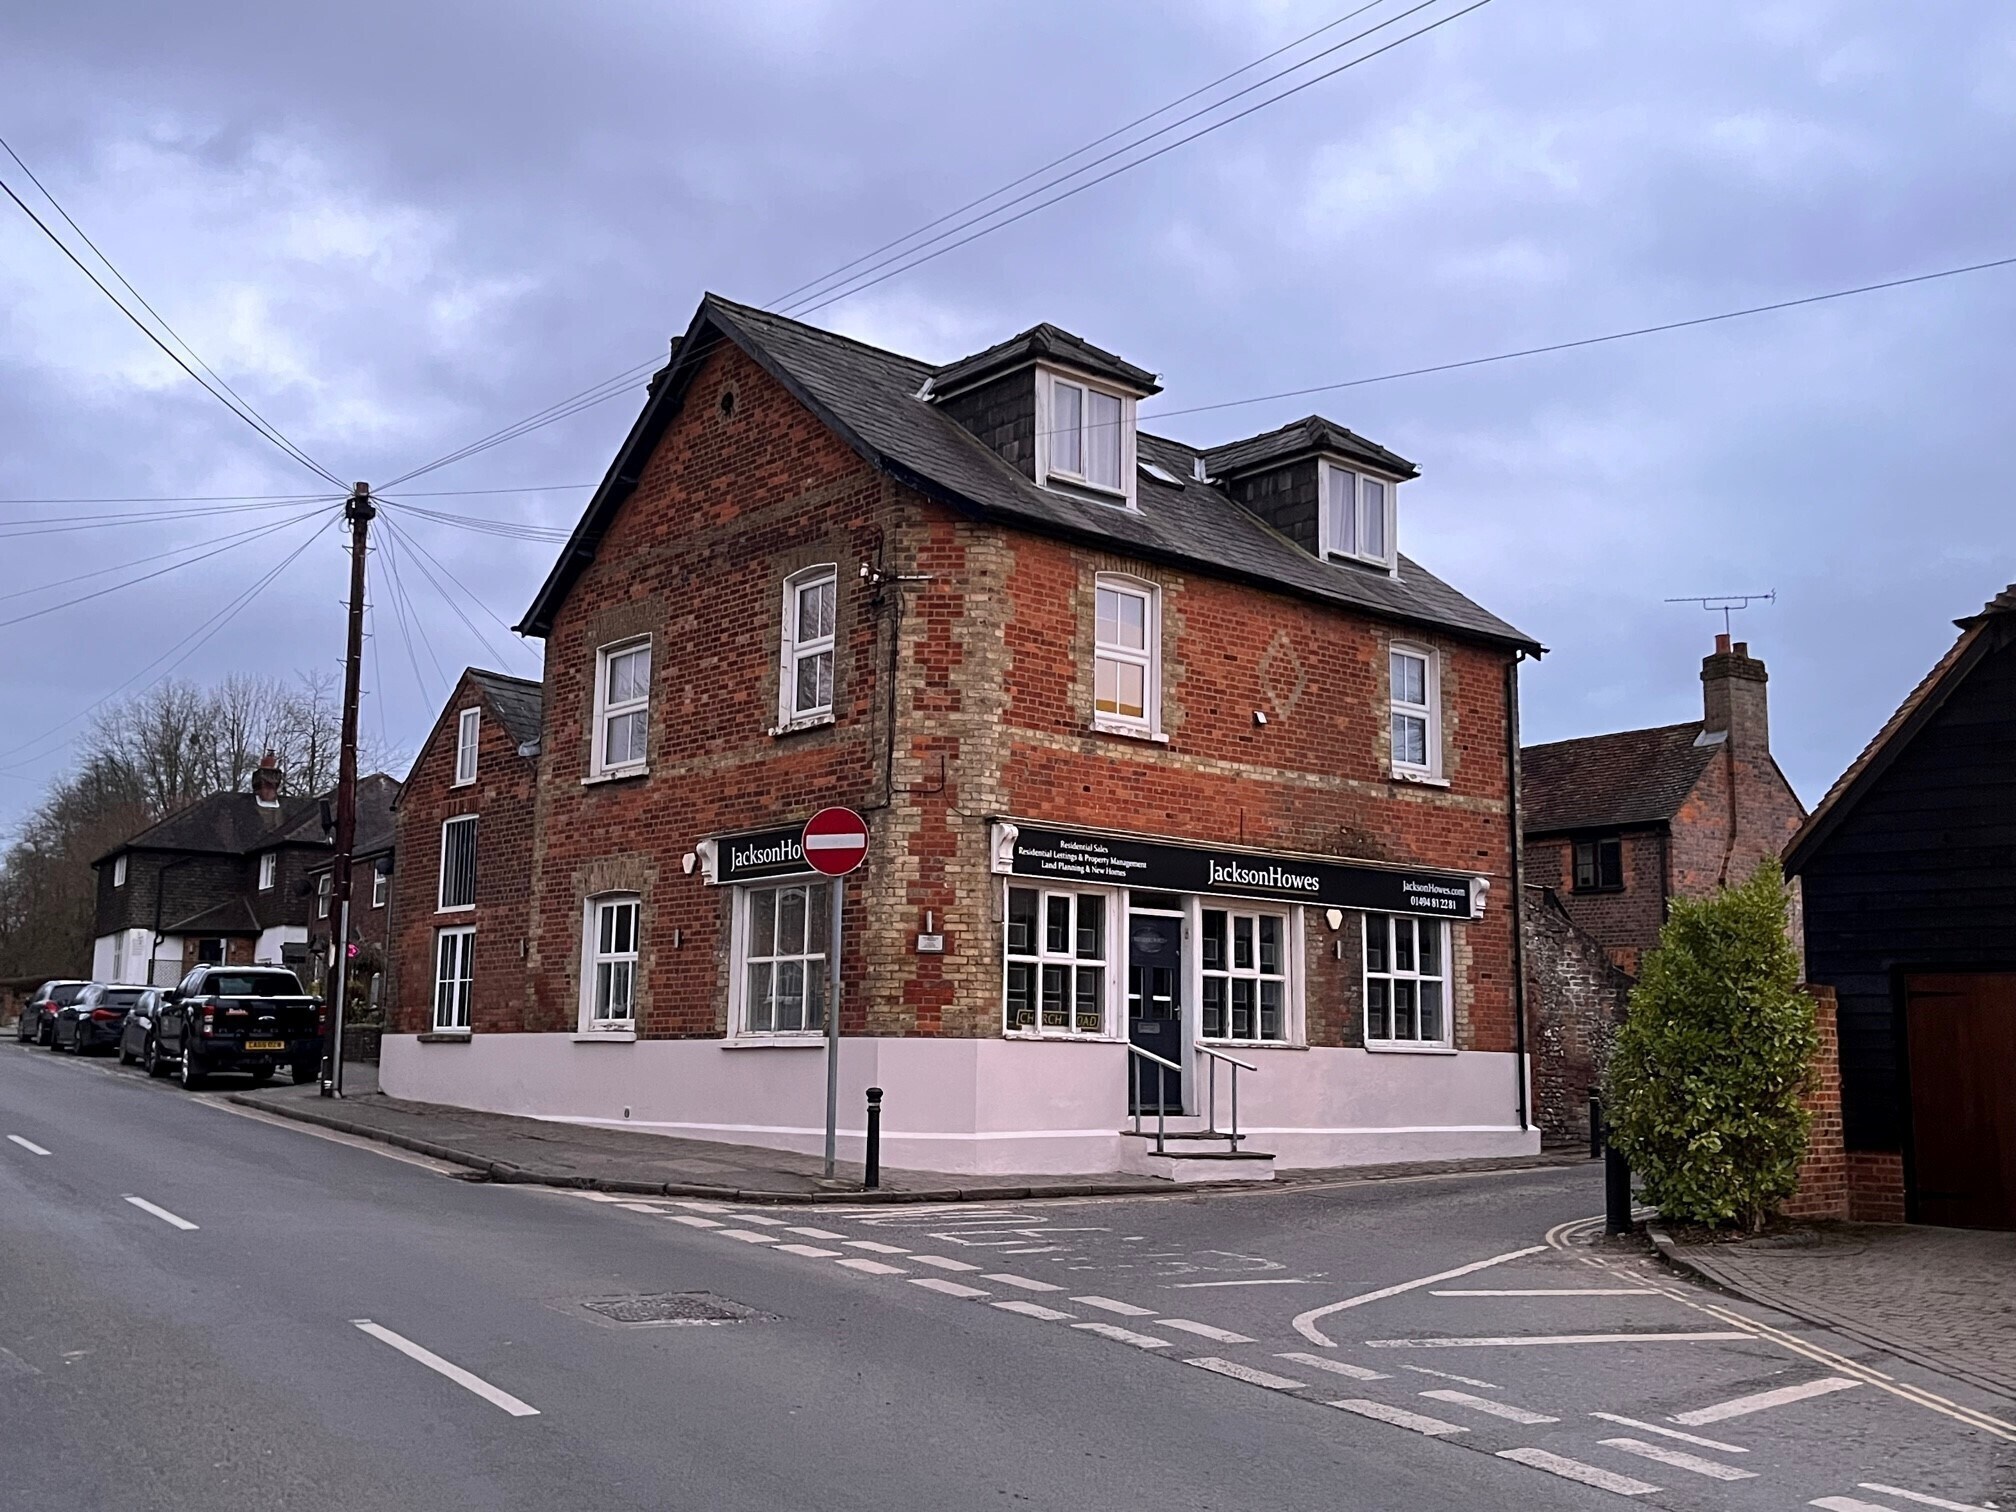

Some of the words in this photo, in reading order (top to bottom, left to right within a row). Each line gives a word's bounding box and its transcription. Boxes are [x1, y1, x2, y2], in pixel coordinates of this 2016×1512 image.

[730, 839, 802, 872] JacksonHo
[1060, 840, 1093, 852] Residential
[1093, 844, 1109, 854] Sales
[1018, 846, 1052, 858] Residential
[1053, 851, 1078, 862] Lettings
[1078, 853, 1083, 861] &
[1084, 854, 1109, 865] Property
[1110, 857, 1147, 869] Management
[1041, 860, 1057, 870] Land
[1058, 861, 1085, 875] Planning
[1085, 865, 1091, 873] &
[1091, 866, 1105, 874] New
[1105, 866, 1127, 877] Homes
[1207, 859, 1320, 891] JacksonHowes
[1402, 880, 1466, 897] JacksonHowes.com
[1410, 895, 1431, 907] 01494
[1019, 1012, 1063, 1025] CHRCH
[1076, 1015, 1097, 1027] OAD
